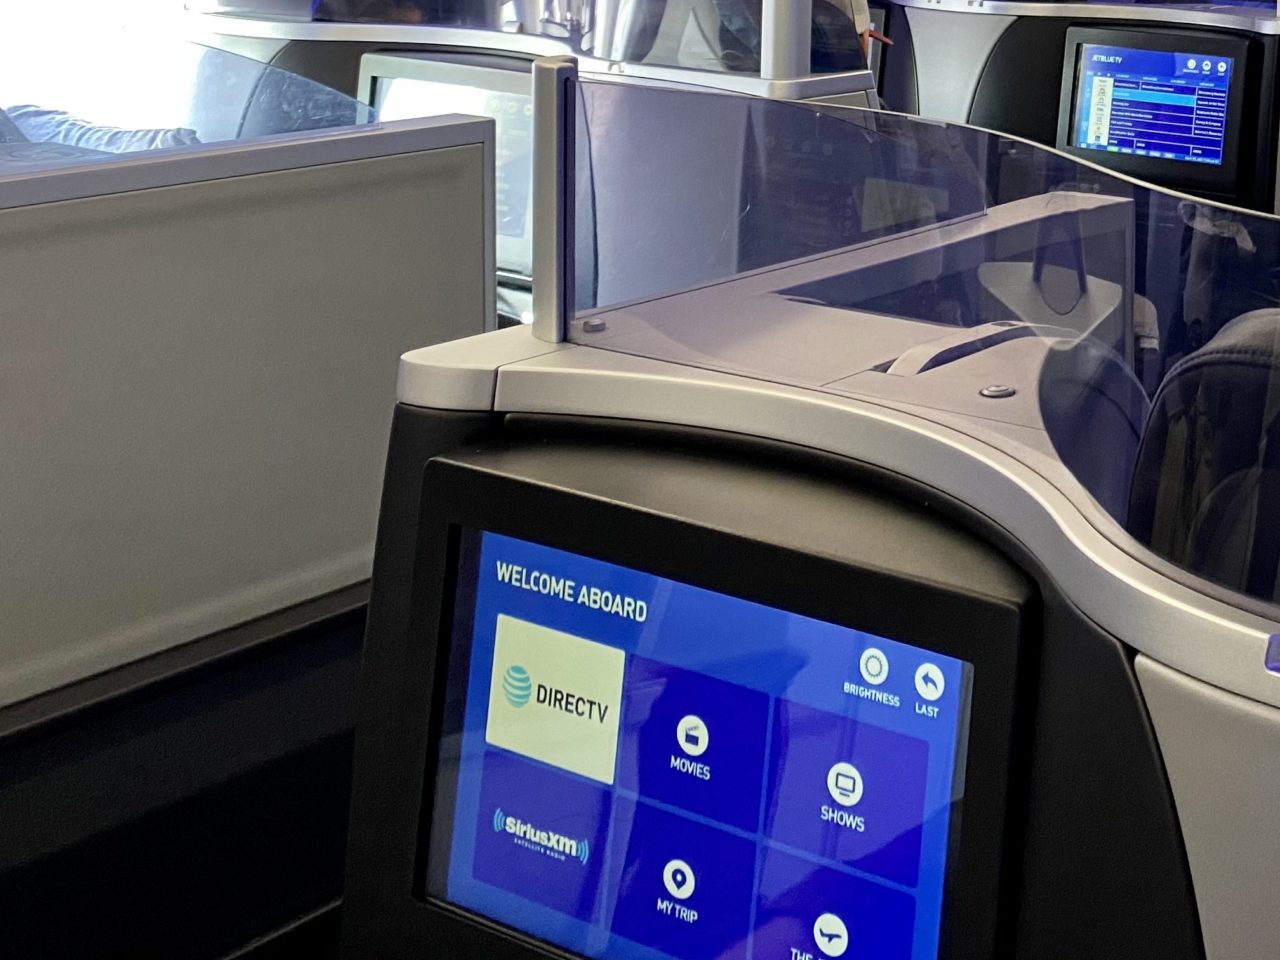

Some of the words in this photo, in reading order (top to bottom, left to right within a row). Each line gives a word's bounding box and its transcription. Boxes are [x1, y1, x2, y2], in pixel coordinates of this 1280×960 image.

[496, 560, 576, 602] WELCOME
[577, 585, 647, 622] ABOARD
[536, 683, 608, 724] DIRECTV
[843, 681, 900, 708] BRIGHTNESS
[915, 702, 939, 718] LAST
[670, 755, 711, 781] MOVIES
[820, 805, 865, 832] SHOWS
[657, 897, 674, 916] MY
[675, 903, 698, 924] TRIP
